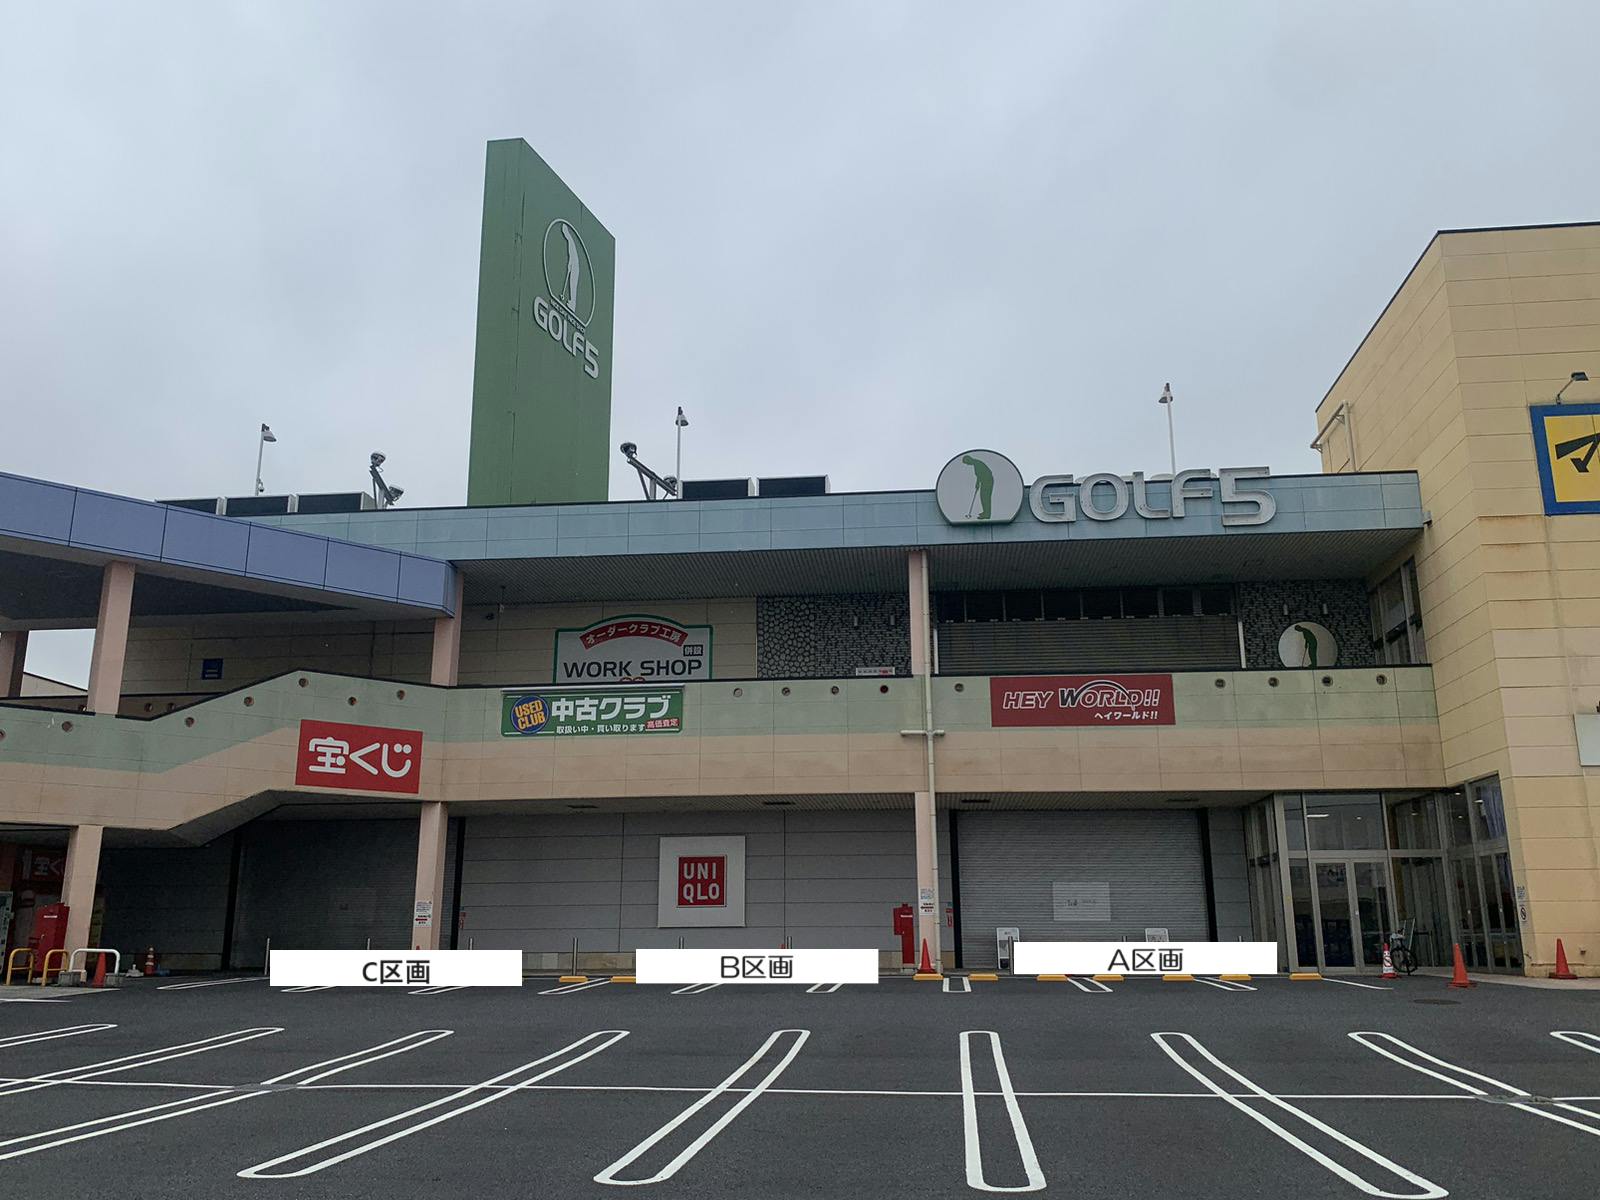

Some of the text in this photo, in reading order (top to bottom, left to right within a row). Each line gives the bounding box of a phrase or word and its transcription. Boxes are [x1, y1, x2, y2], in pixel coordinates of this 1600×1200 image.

[533, 296, 599, 379] GOLF5
[1029, 466, 1277, 526] GOLF5
[585, 623, 682, 645] オーダークラブ工房
[563, 659, 702, 678] WORK SHOP
[1003, 680, 1160, 711] HEY WORLD!!
[514, 700, 544, 718] USED
[551, 695, 671, 722] 中古クラブ
[1094, 711, 1158, 720] ヘイワールド!!
[517, 712, 546, 730] CLUB
[309, 736, 412, 778] 宝くじ
[683, 862, 717, 880] UNI
[682, 883, 720, 904] QLO
